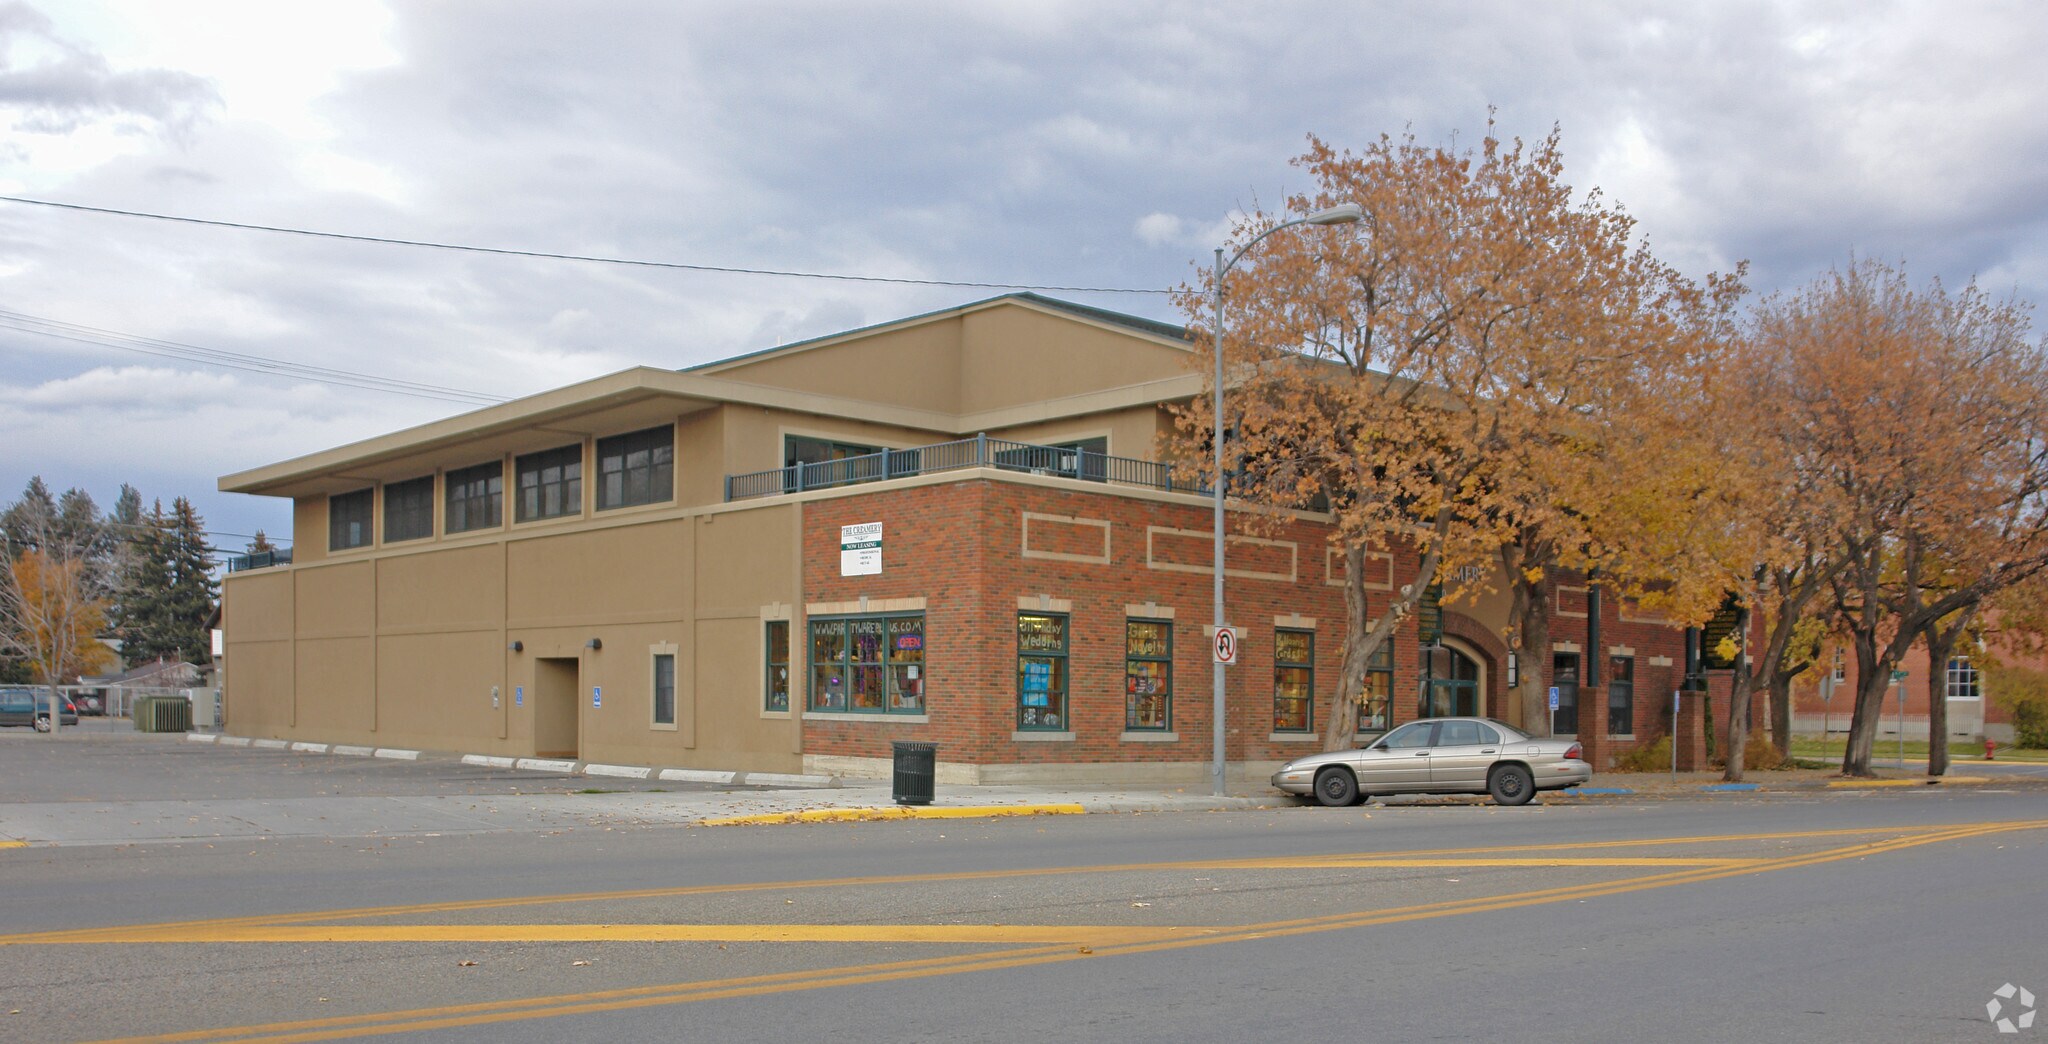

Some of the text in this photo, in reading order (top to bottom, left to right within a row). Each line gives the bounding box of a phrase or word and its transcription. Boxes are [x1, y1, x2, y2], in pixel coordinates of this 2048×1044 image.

[843, 524, 881, 535] THE CREAMERY
[857, 541, 877, 549] LEASING
[899, 637, 921, 648] OPEN
